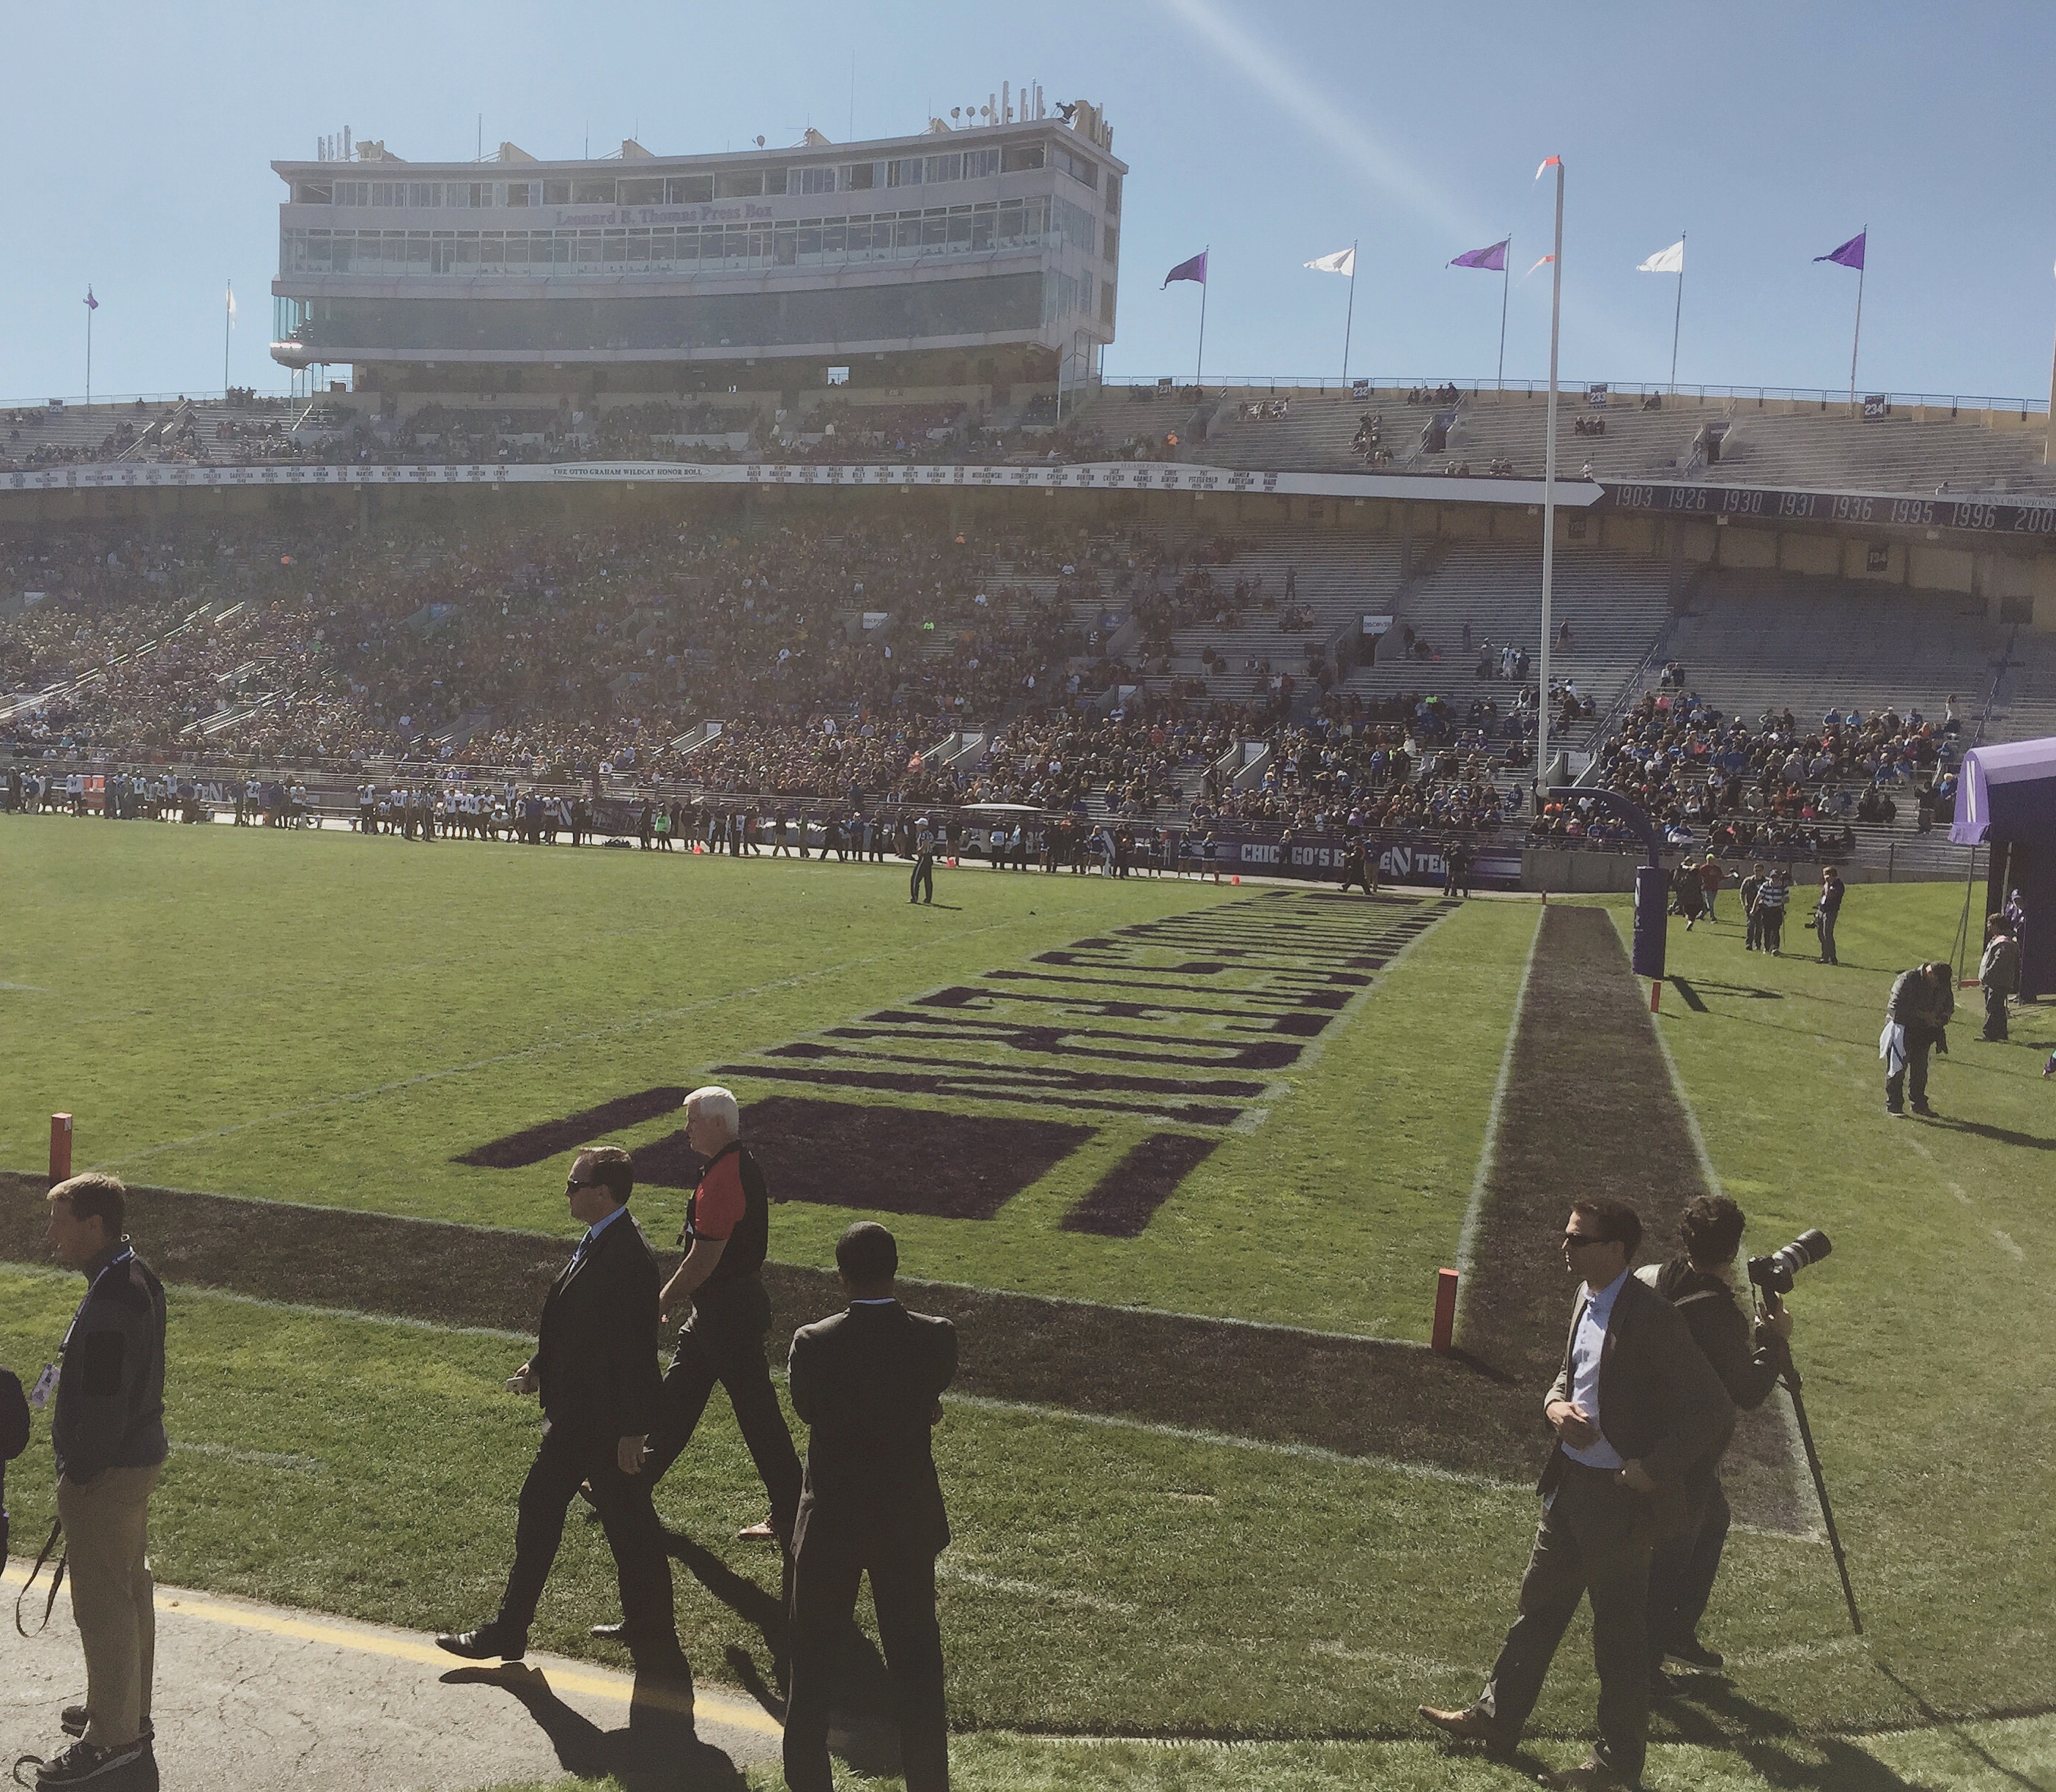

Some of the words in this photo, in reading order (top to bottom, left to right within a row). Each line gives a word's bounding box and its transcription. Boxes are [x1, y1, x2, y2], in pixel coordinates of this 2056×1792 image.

[555, 210, 615, 226] Leonard
[639, 208, 697, 223] Thomas
[699, 206, 741, 221] Press
[744, 203, 774, 218] Box
[1159, 385, 1171, 393] 231
[1353, 387, 1368, 396] 232
[1590, 392, 1606, 403] 233
[1865, 404, 1884, 415] 234
[1616, 486, 1654, 508] 1903
[1668, 487, 1707, 510] 1926
[1722, 489, 1764, 513] 1930
[1778, 493, 1817, 517] 1931
[1831, 495, 1874, 521] 1936
[1890, 499, 1934, 525] 1995
[1951, 503, 1998, 529] 1996
[2014, 507, 2056, 533] 200
[1241, 844, 1329, 866] CHICGO'S
[1379, 846, 1411, 876] EN
